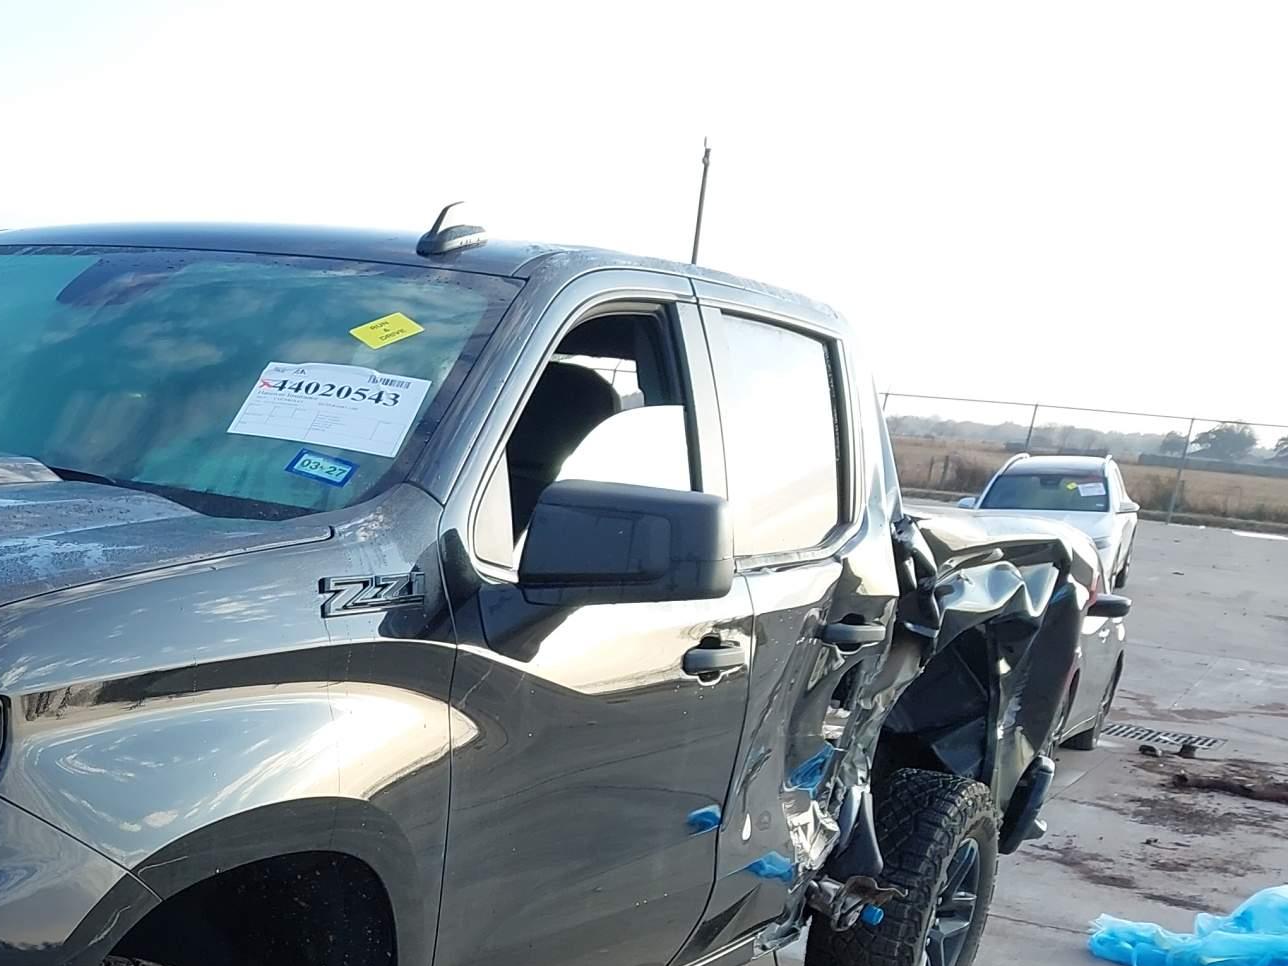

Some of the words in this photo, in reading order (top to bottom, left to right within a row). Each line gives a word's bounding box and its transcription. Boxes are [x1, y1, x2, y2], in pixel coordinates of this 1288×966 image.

[369, 321, 389, 331] RUN
[379, 328, 406, 342] DRIVE
[273, 379, 401, 407] 44020543
[318, 571, 425, 619] Z71
